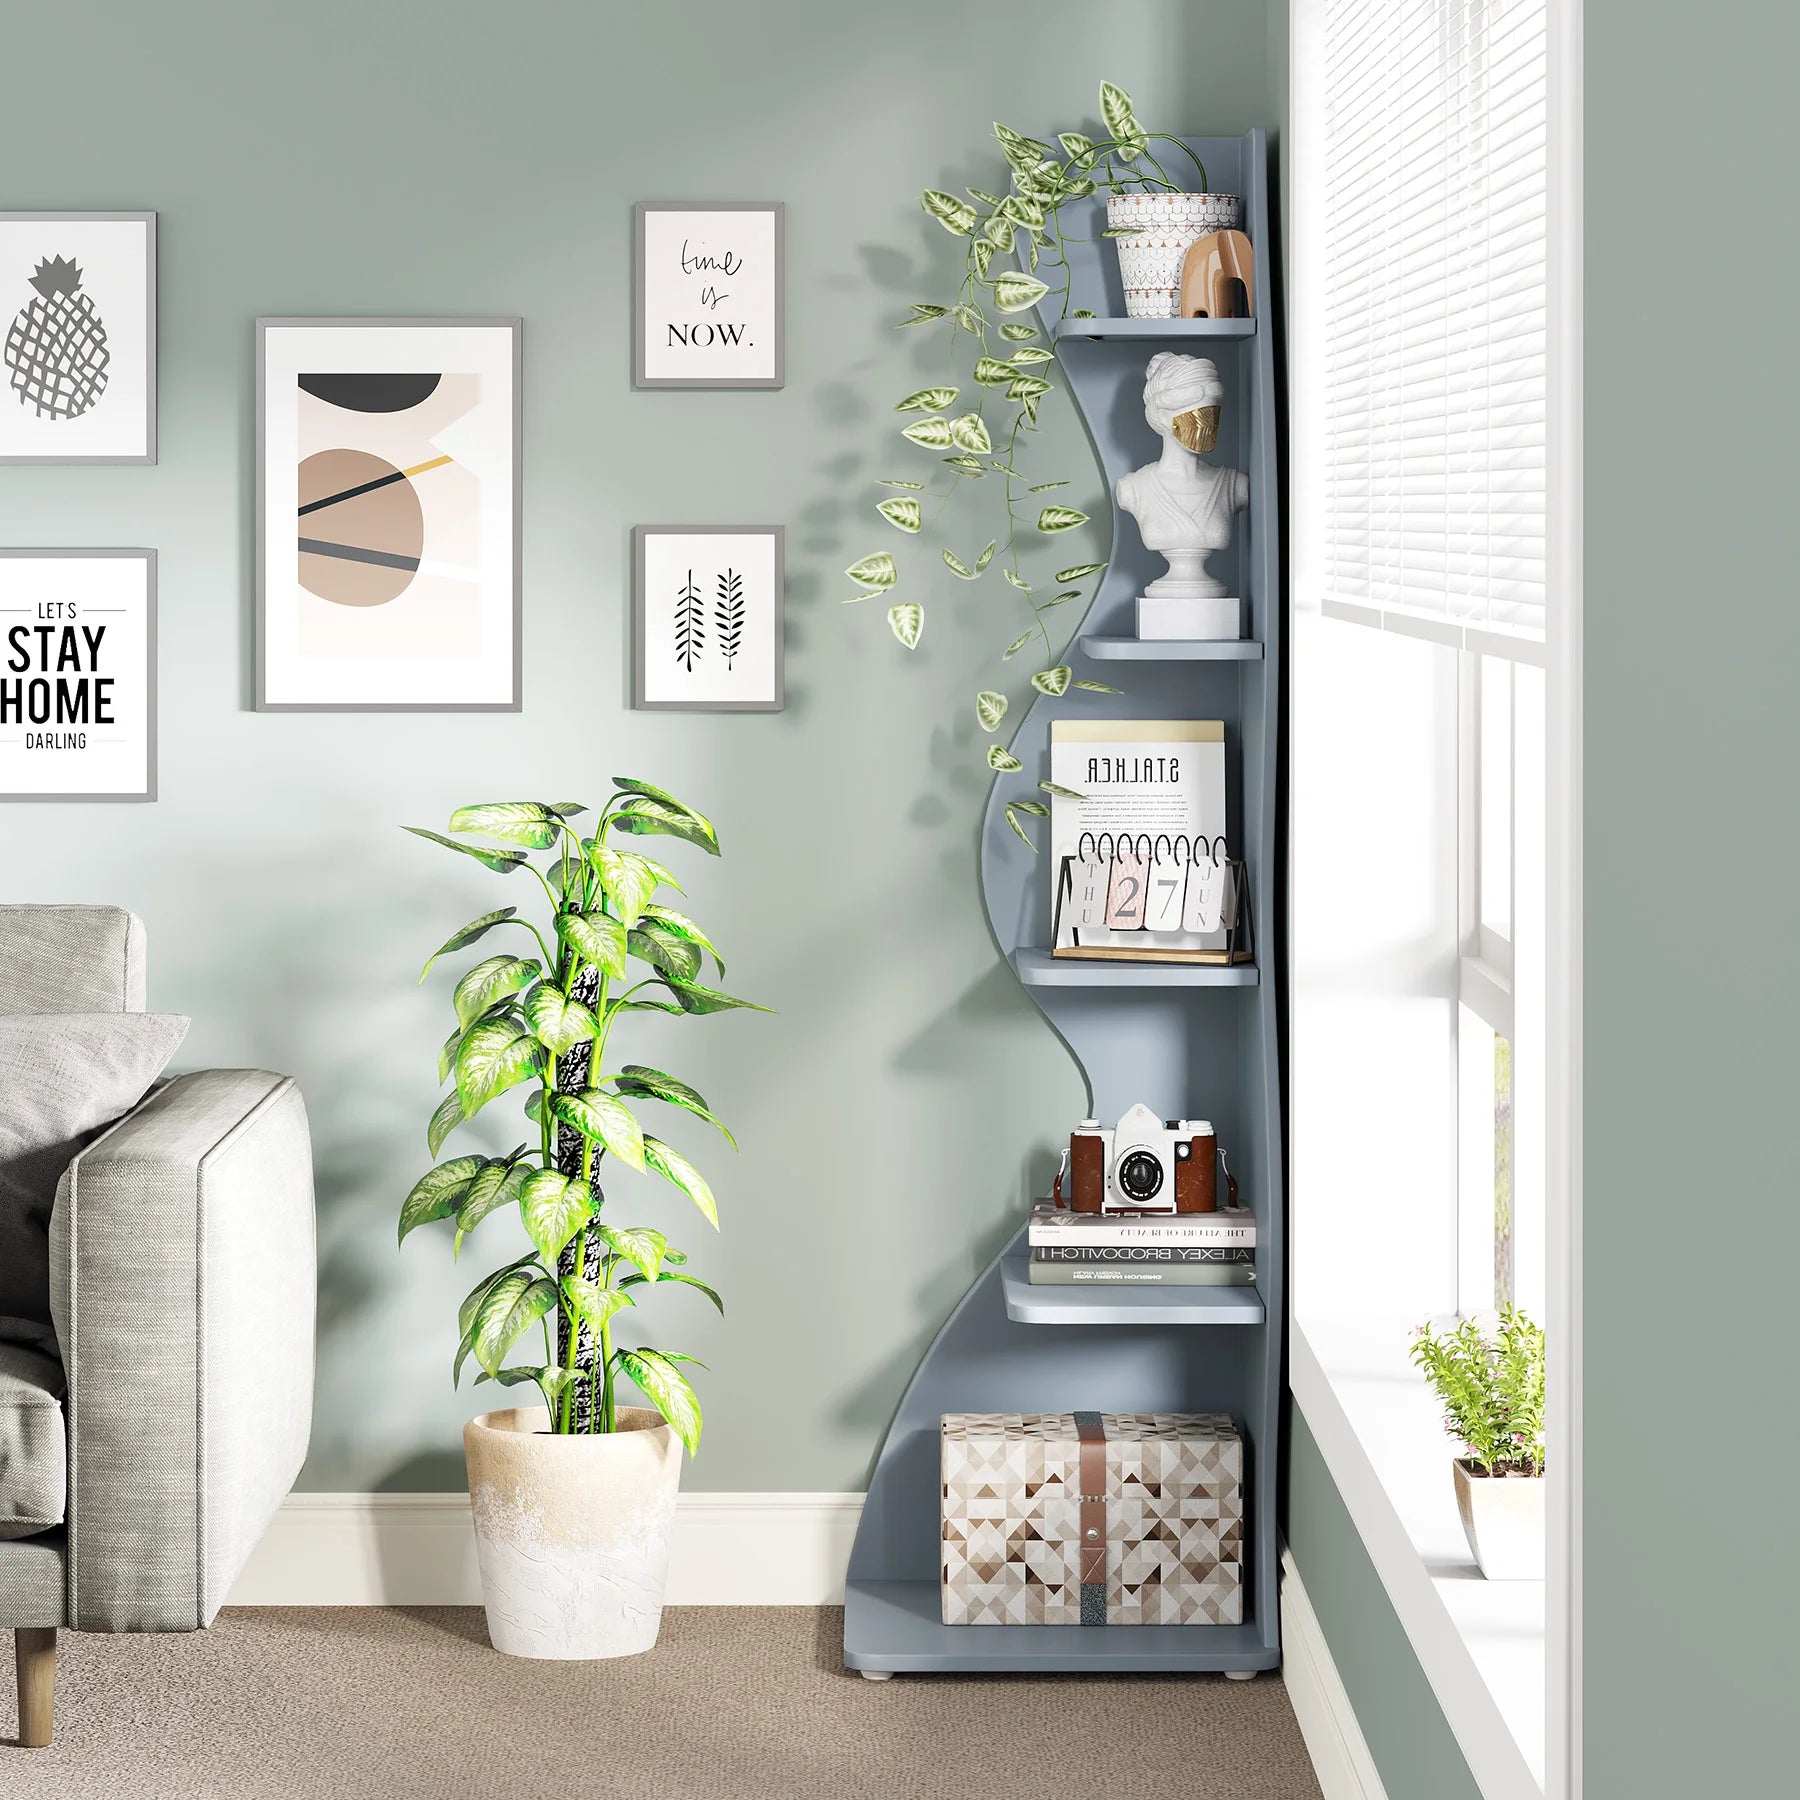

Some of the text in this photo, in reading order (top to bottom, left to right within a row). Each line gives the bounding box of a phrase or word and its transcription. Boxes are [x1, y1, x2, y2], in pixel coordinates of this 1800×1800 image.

[681, 239, 742, 276] time
[702, 281, 729, 310] is
[667, 323, 753, 347] NOW.
[8, 626, 107, 673] STAY
[0, 678, 115, 724] HOME
[26, 733, 87, 749] DARLING
